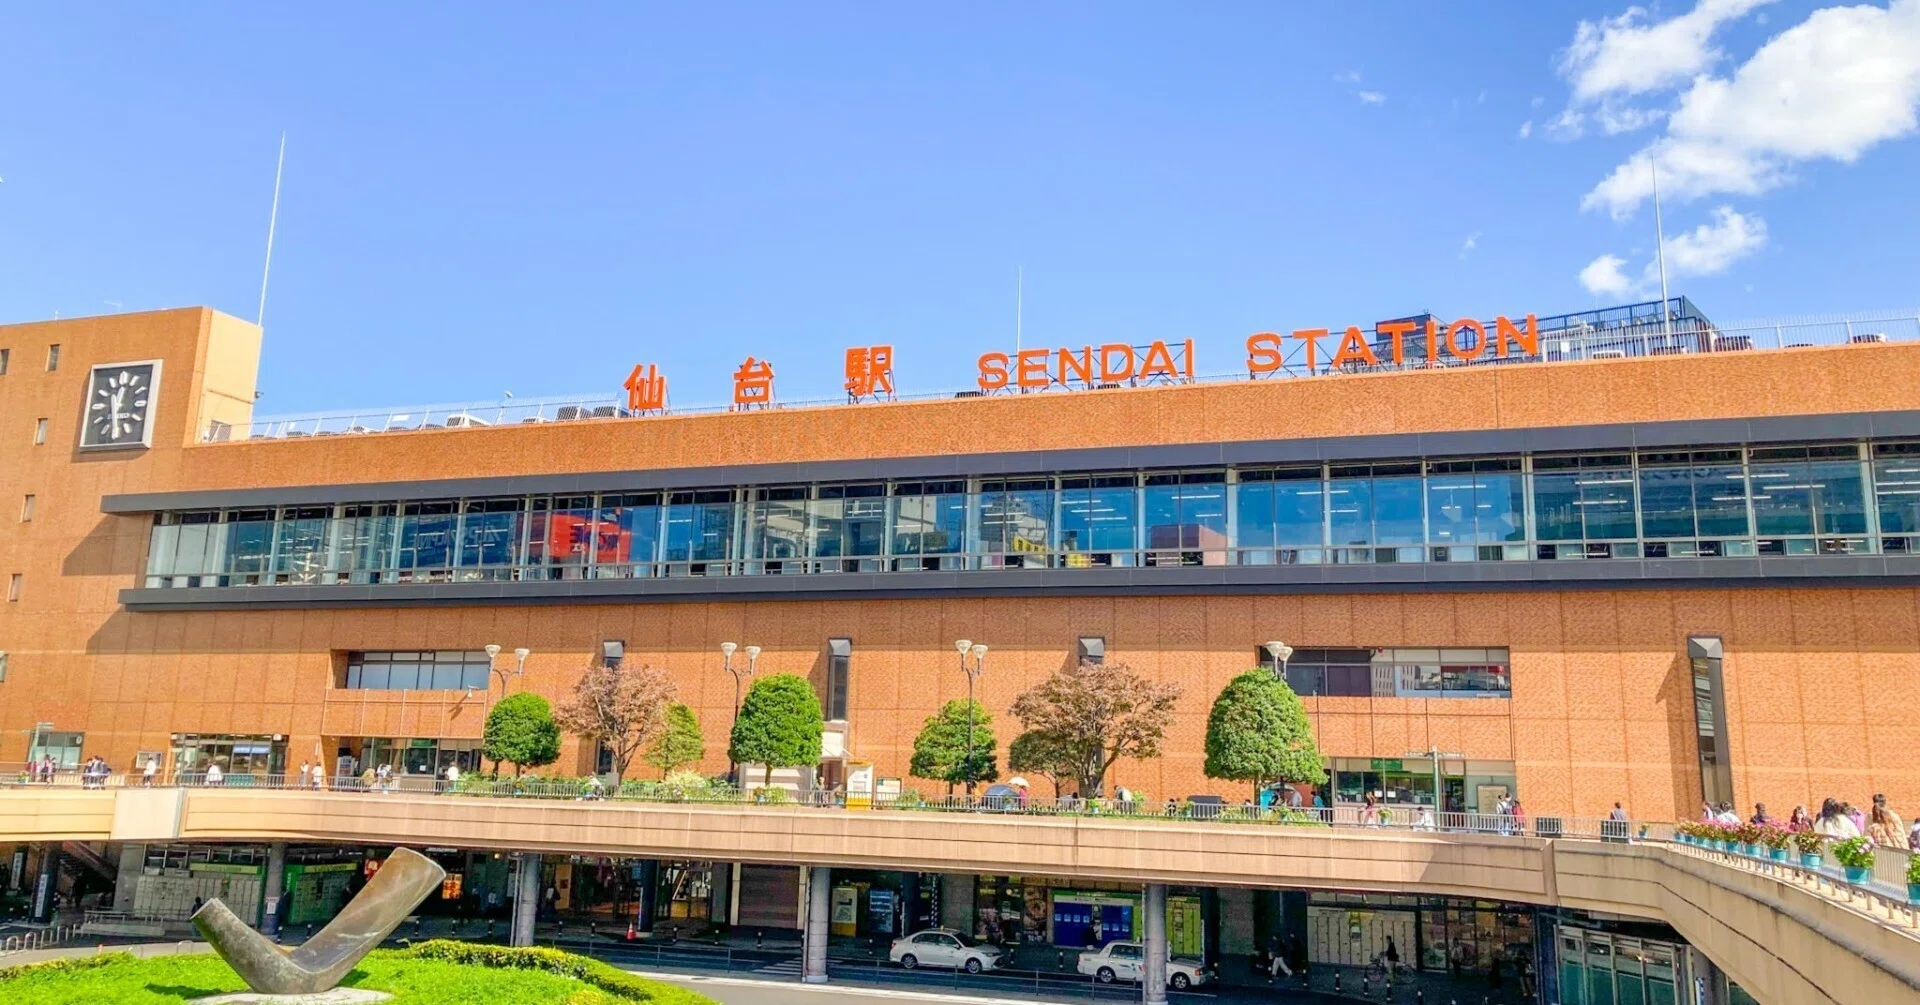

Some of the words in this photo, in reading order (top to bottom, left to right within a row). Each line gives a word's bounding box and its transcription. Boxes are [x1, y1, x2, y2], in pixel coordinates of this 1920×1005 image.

[623, 345, 893, 410] 仙台駅
[978, 338, 1194, 389] SENDAI
[1246, 314, 1538, 372] STATION
